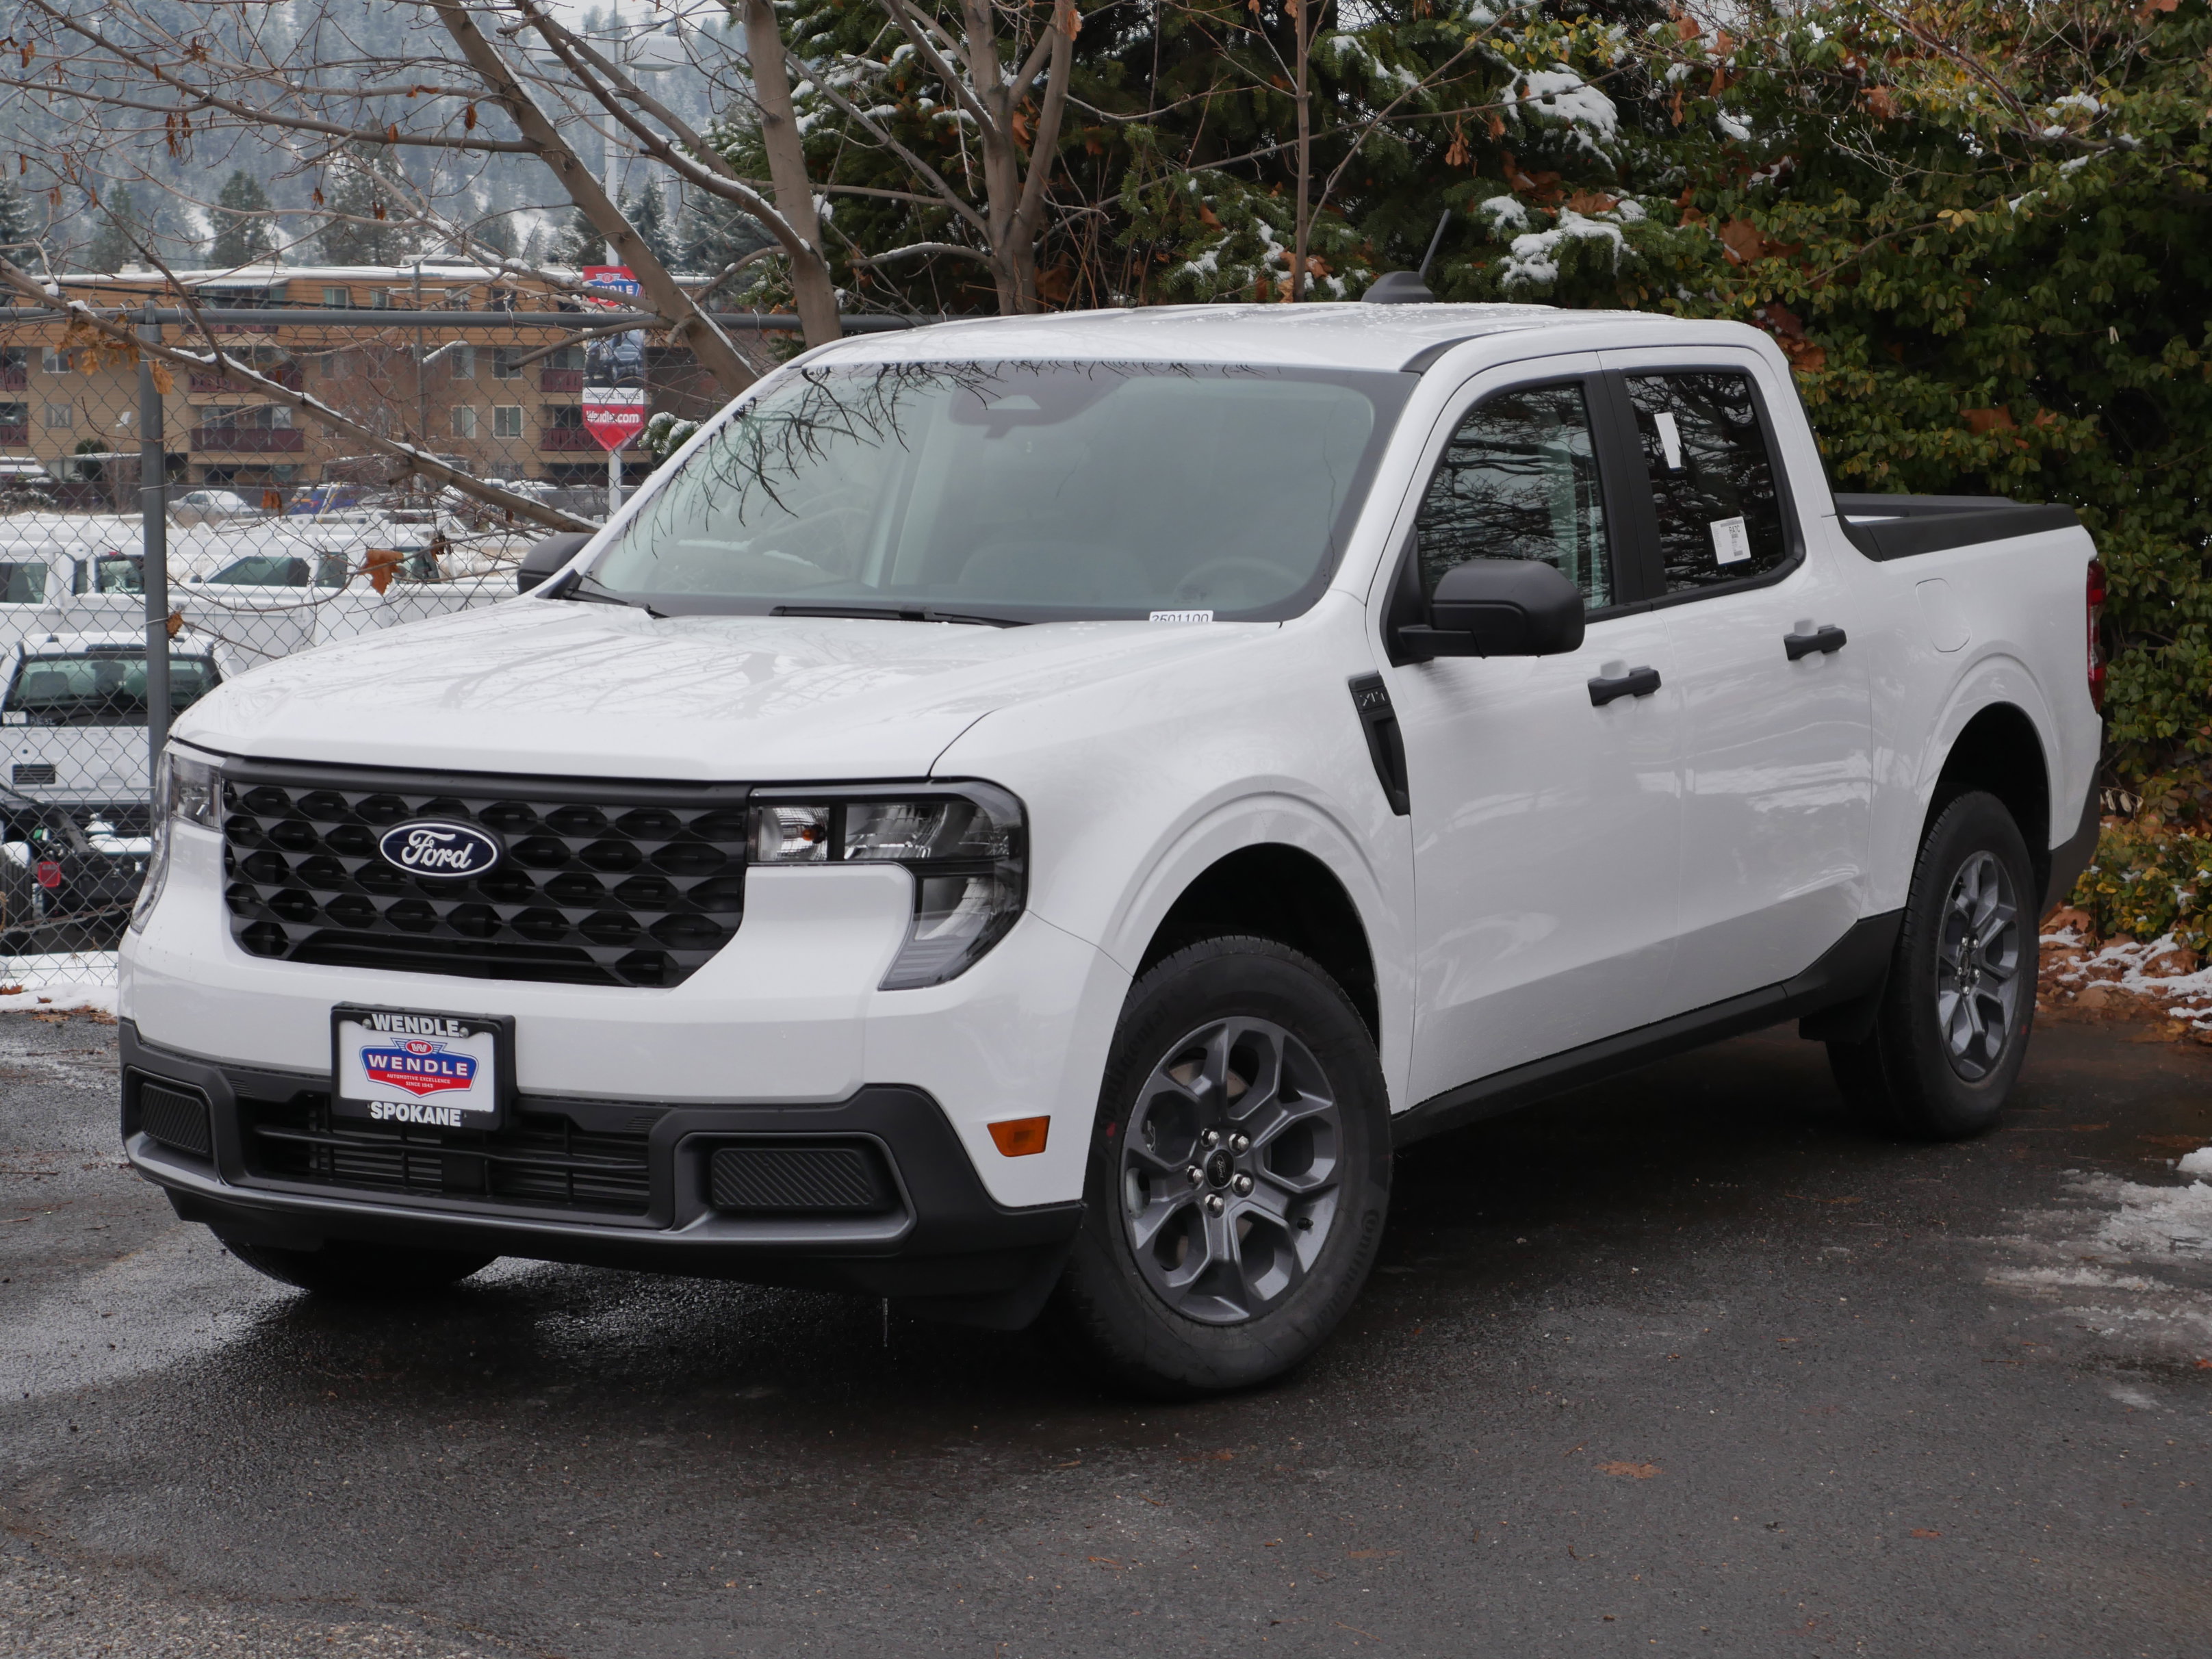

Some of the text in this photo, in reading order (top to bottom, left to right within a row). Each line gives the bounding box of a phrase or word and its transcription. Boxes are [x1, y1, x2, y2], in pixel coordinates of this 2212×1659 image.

[596, 285, 633, 294] DLE
[401, 830, 474, 869] Ford
[371, 1014, 461, 1038] WENDLE
[368, 1054, 468, 1077] WENDLE
[370, 1102, 462, 1127] SPOKANE
